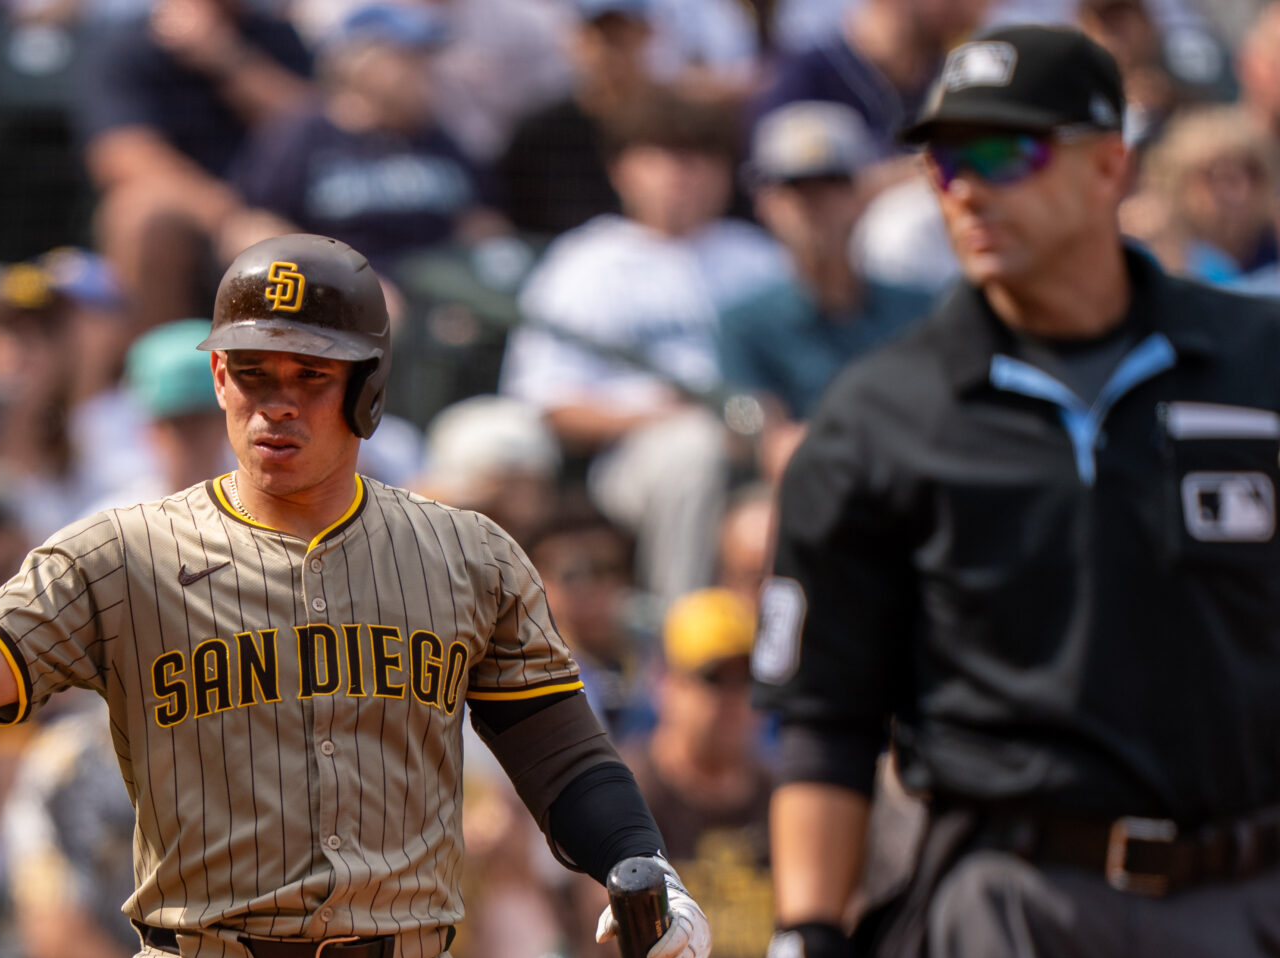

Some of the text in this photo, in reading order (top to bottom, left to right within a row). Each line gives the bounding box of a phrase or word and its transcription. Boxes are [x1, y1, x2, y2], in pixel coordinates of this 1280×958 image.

[265, 261, 306, 312] SD
[151, 623, 469, 728] SAN DIEGO
